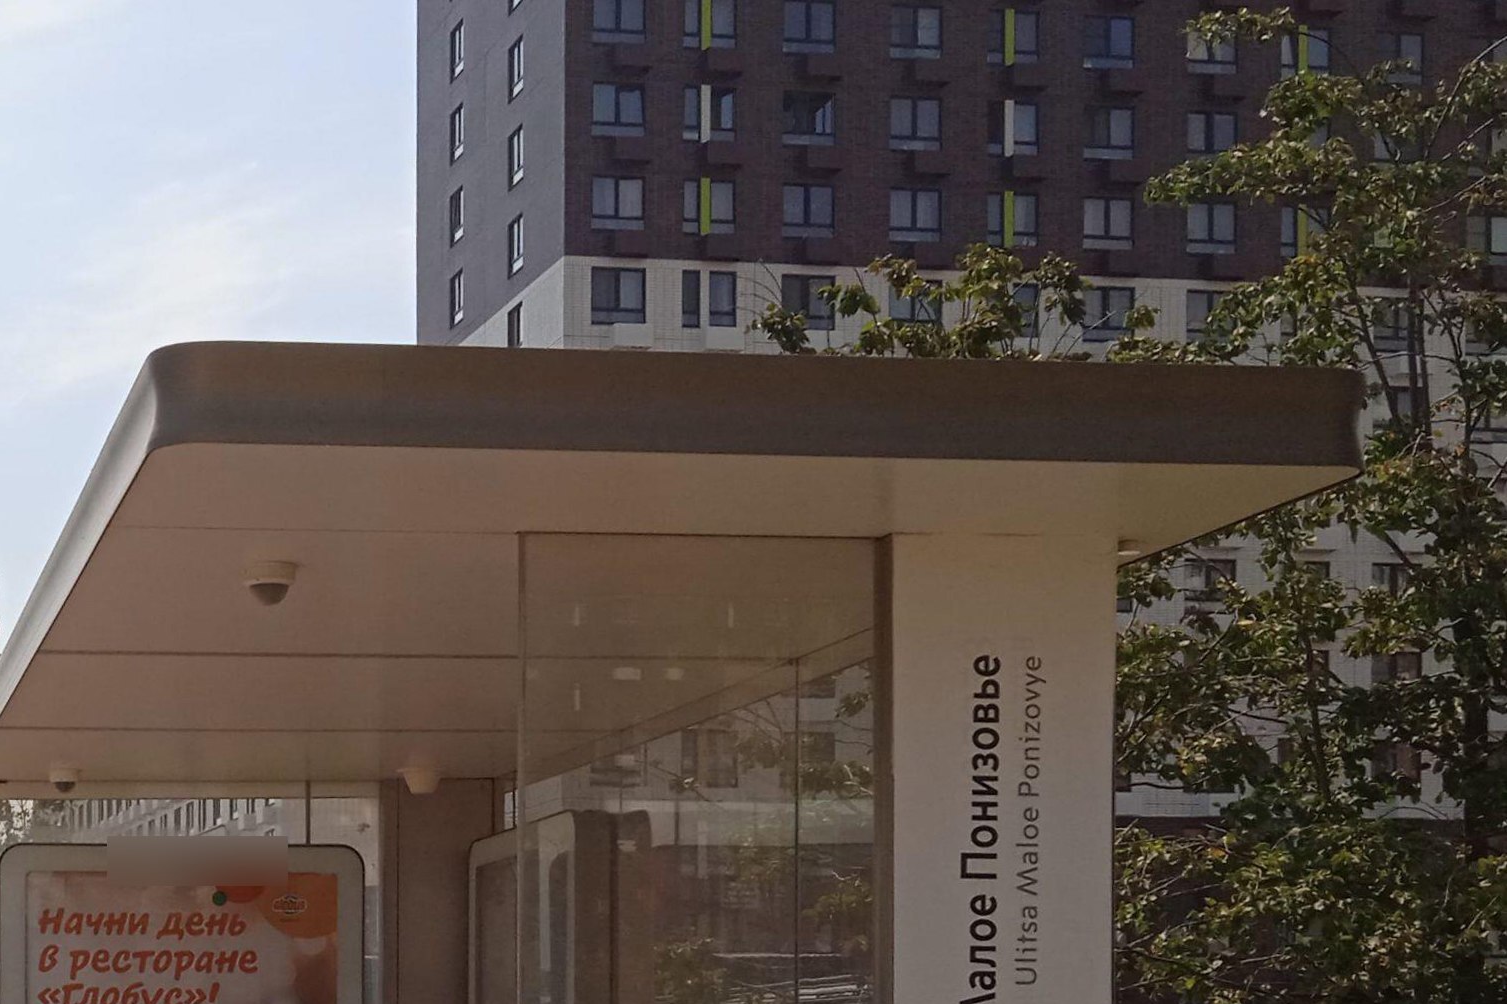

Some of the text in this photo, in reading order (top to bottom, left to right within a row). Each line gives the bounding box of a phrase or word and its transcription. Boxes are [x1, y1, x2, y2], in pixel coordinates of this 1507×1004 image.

[960, 654, 1001, 880] Понизовье
[1014, 655, 1047, 986] Ulitsa Maloe Ponizovye
[38, 908, 247, 940] Начни день
[39, 944, 259, 981] в ресторане
